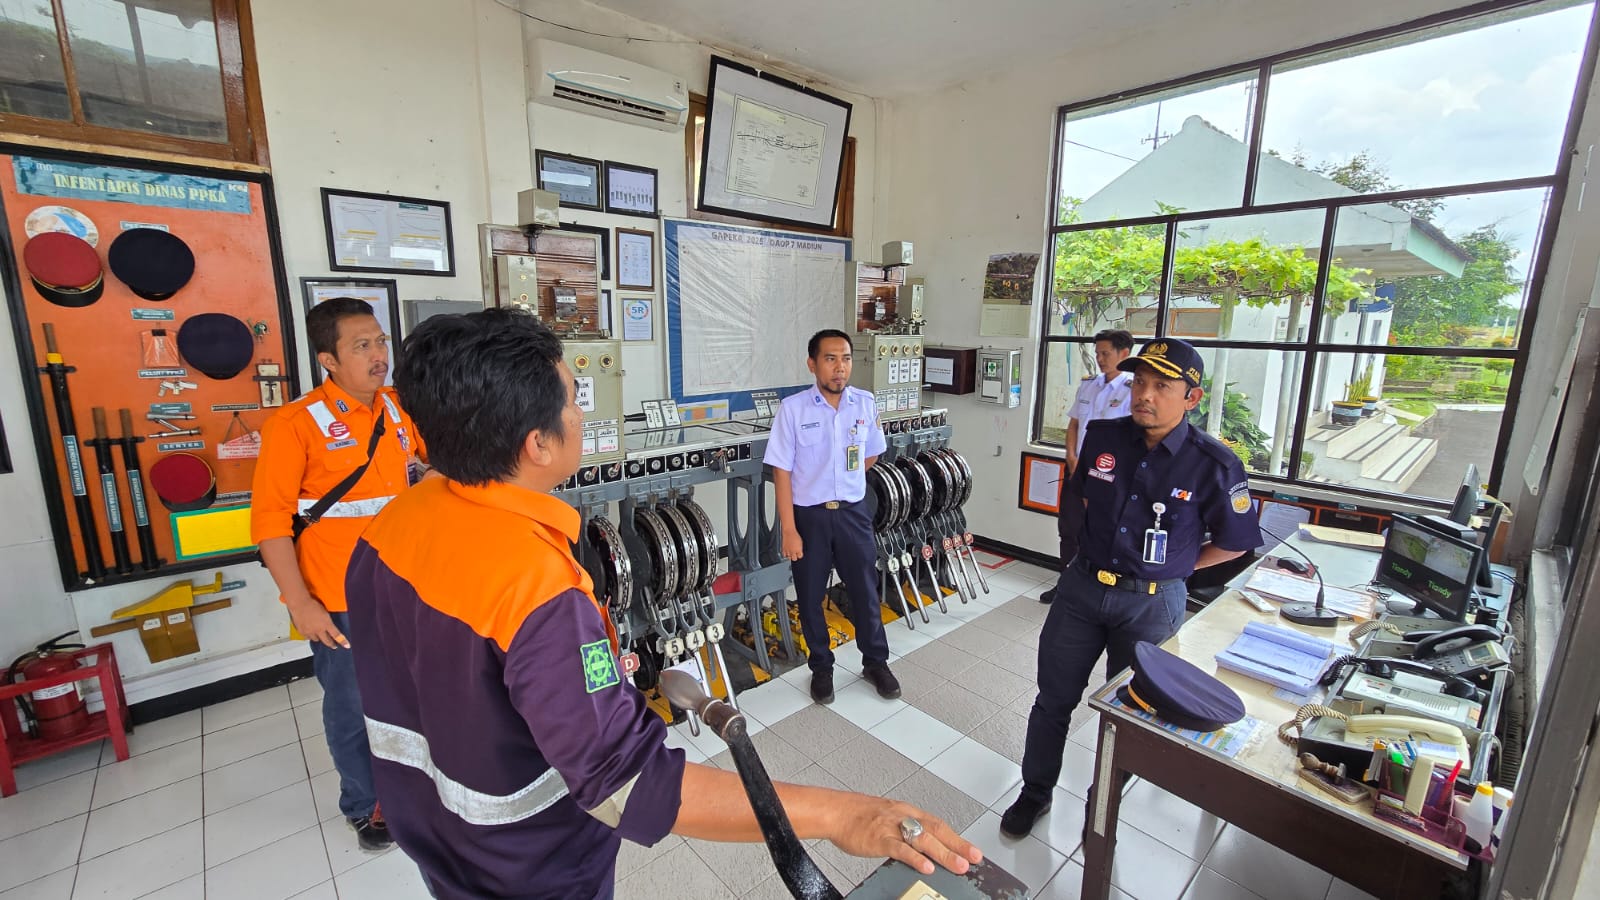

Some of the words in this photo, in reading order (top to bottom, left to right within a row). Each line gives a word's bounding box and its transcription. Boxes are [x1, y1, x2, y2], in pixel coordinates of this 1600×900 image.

[53, 173, 140, 195] INFENTARIS
[144, 183, 186, 199] DINAS
[188, 187, 227, 203] PPKA
[796, 241, 823, 251] MADIUN
[1171, 488, 1192, 501] KAI
[1428, 580, 1452, 598] Tiandy
[712, 626, 720, 639] 3
[671, 641, 679, 654] 5
[692, 635, 699, 647] 4
[625, 659, 634, 670] D
